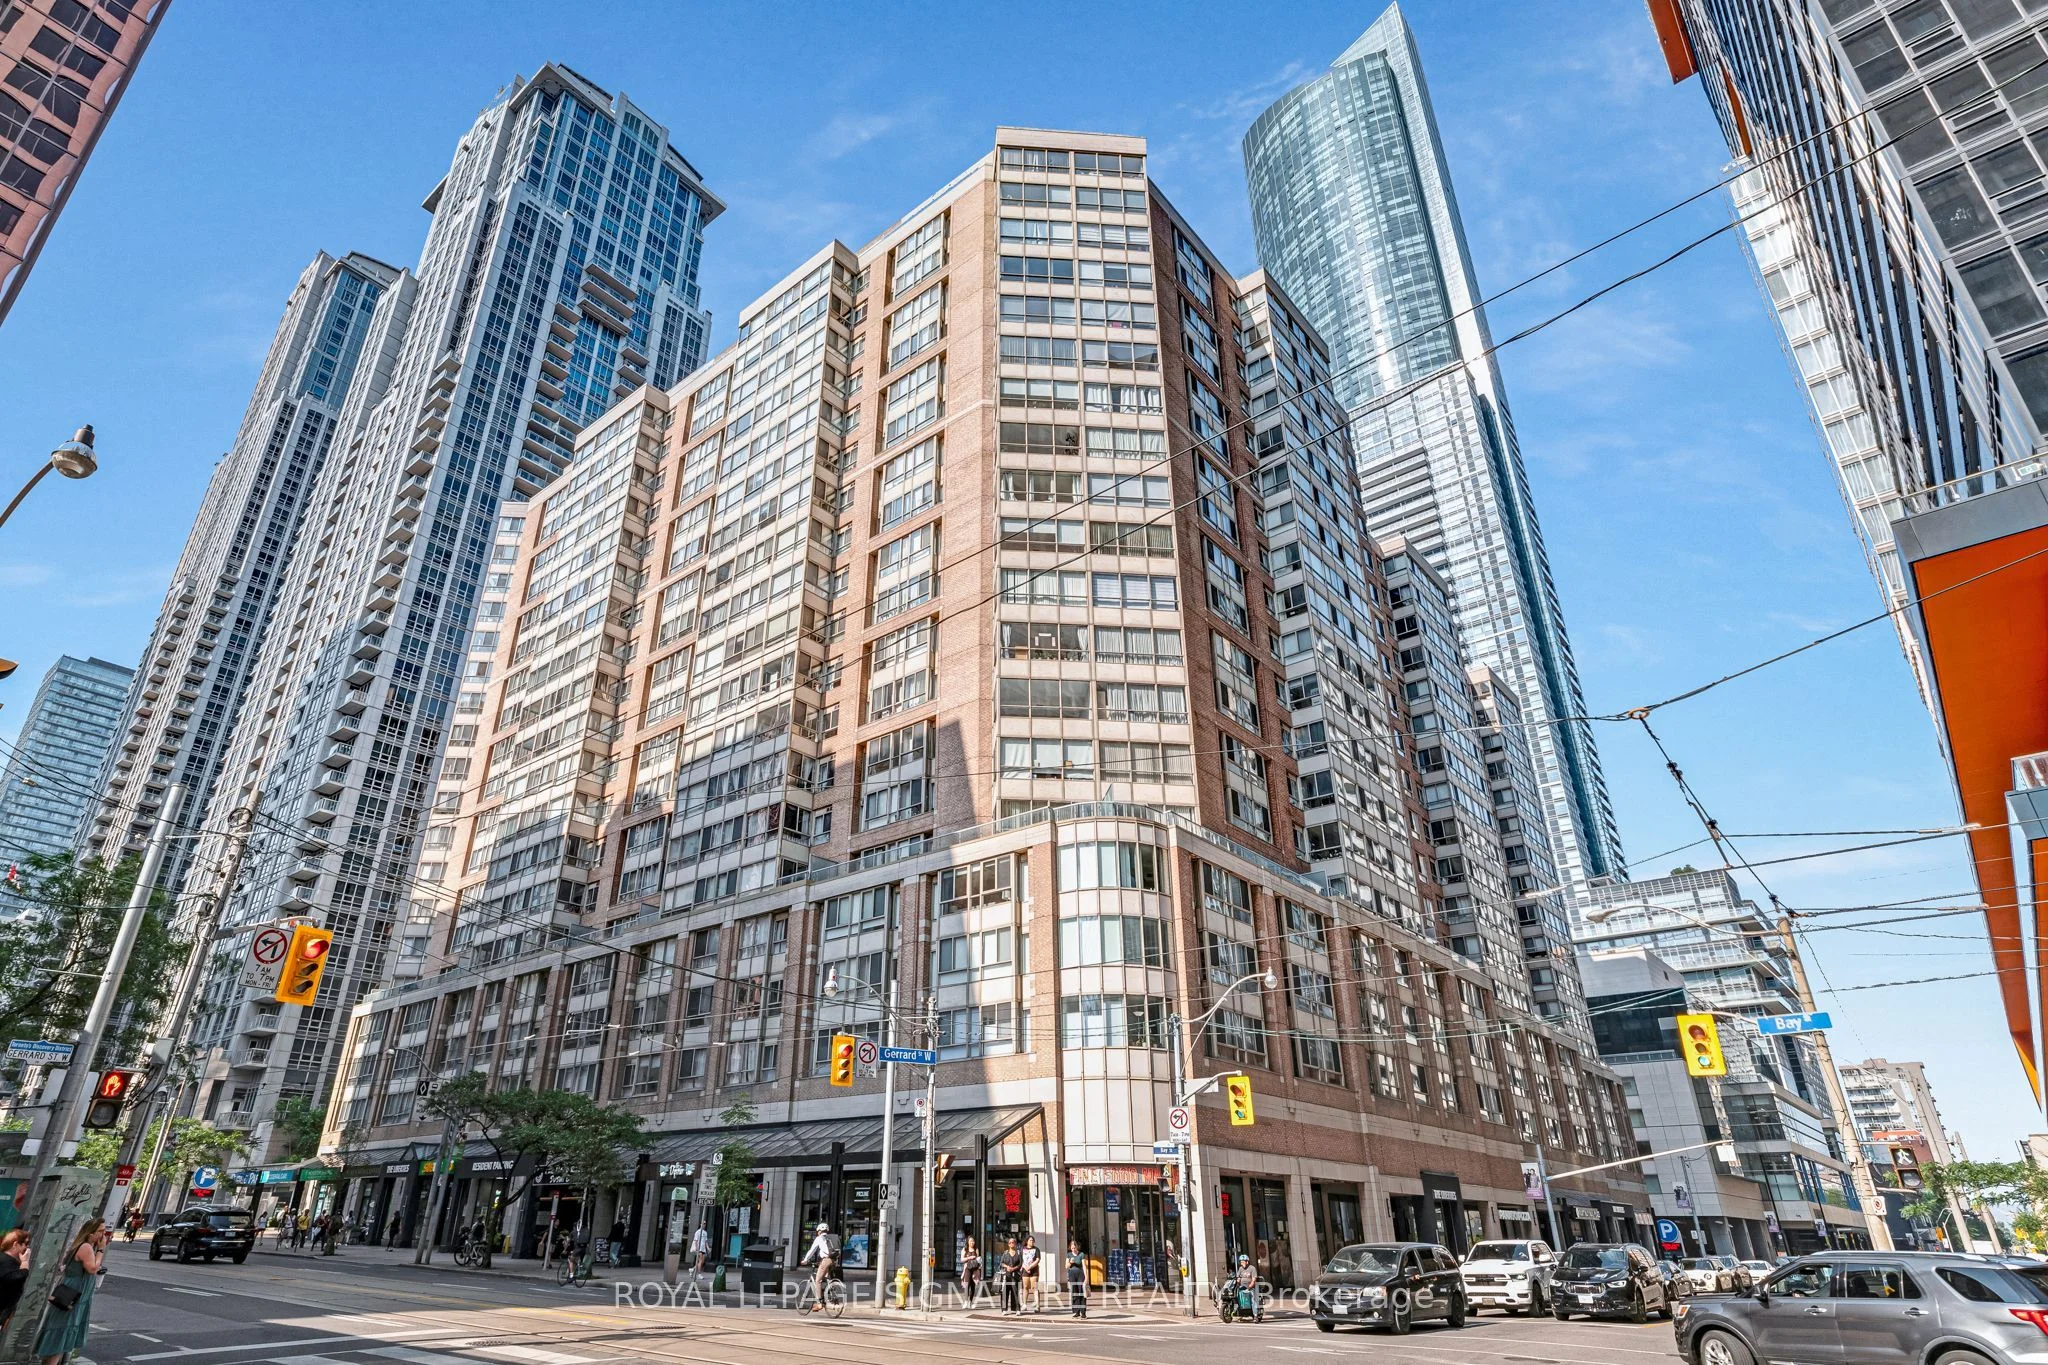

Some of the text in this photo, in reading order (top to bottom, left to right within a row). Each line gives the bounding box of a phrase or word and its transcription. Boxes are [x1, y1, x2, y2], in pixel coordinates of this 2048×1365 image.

[1775, 1017, 1801, 1031] Bay
[11, 1041, 32, 1049] Toronto's
[32, 1043, 54, 1051] Discovery
[8, 1050, 46, 1060] GERRARD
[884, 1048, 916, 1060] Gerrard
[924, 1052, 932, 1061] W
[472, 1162, 493, 1170] RESIDENT
[1070, 1168, 1100, 1184] FINE
[1102, 1168, 1138, 1184] FOOD
